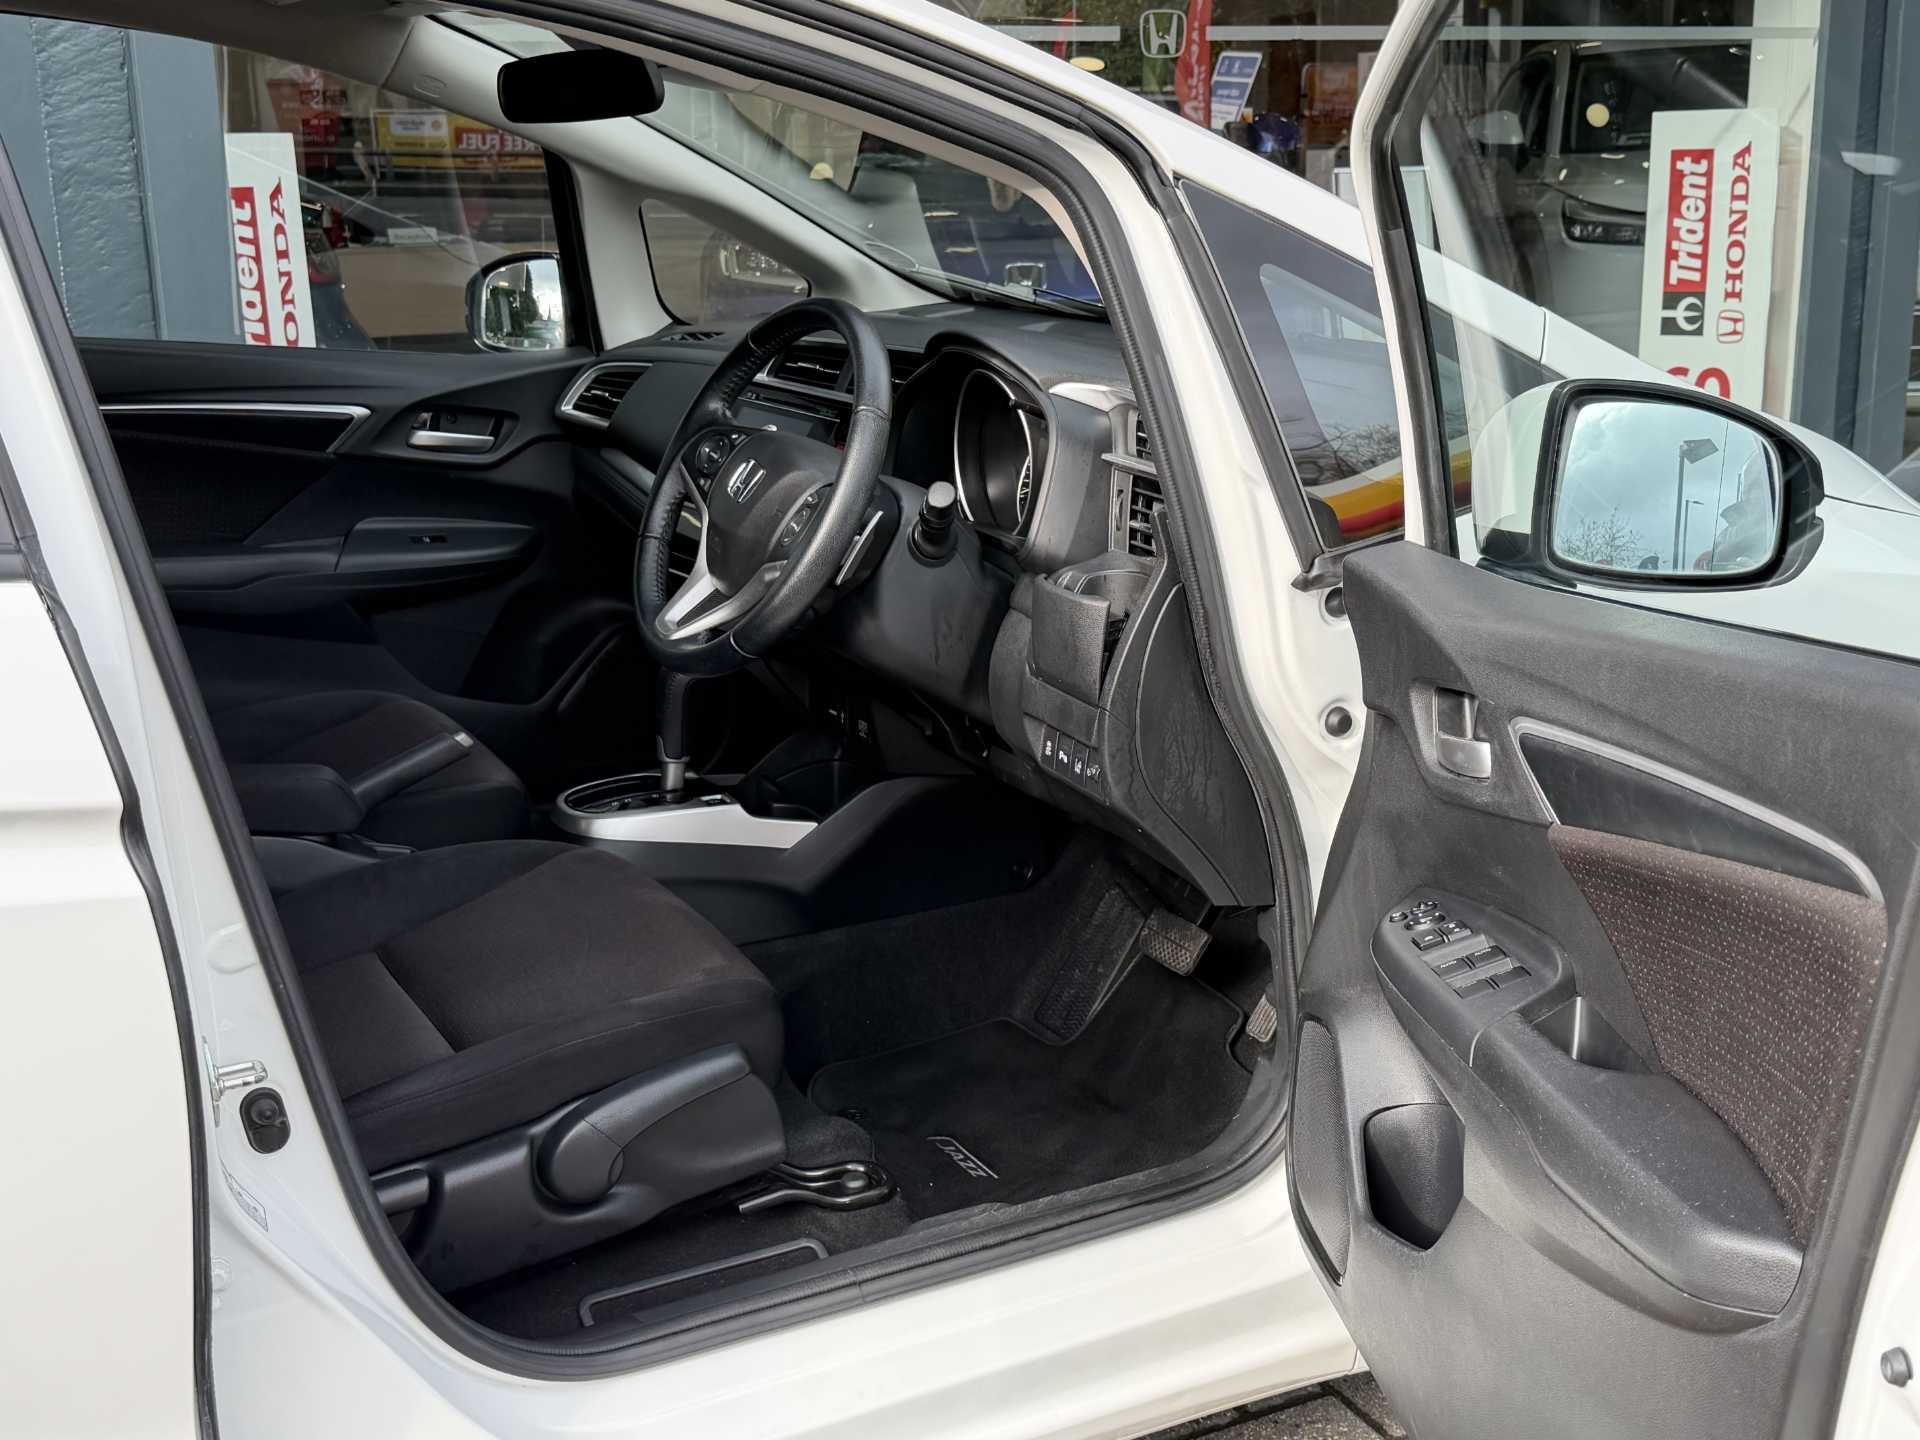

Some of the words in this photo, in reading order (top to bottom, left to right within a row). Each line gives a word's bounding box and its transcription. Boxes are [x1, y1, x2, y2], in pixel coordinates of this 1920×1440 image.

[230, 198, 268, 345] rident
[269, 175, 300, 347] ONDA
[1668, 156, 1709, 286] Trident
[1723, 141, 1753, 303] HONDA
[935, 1142, 989, 1177] JAZZ
